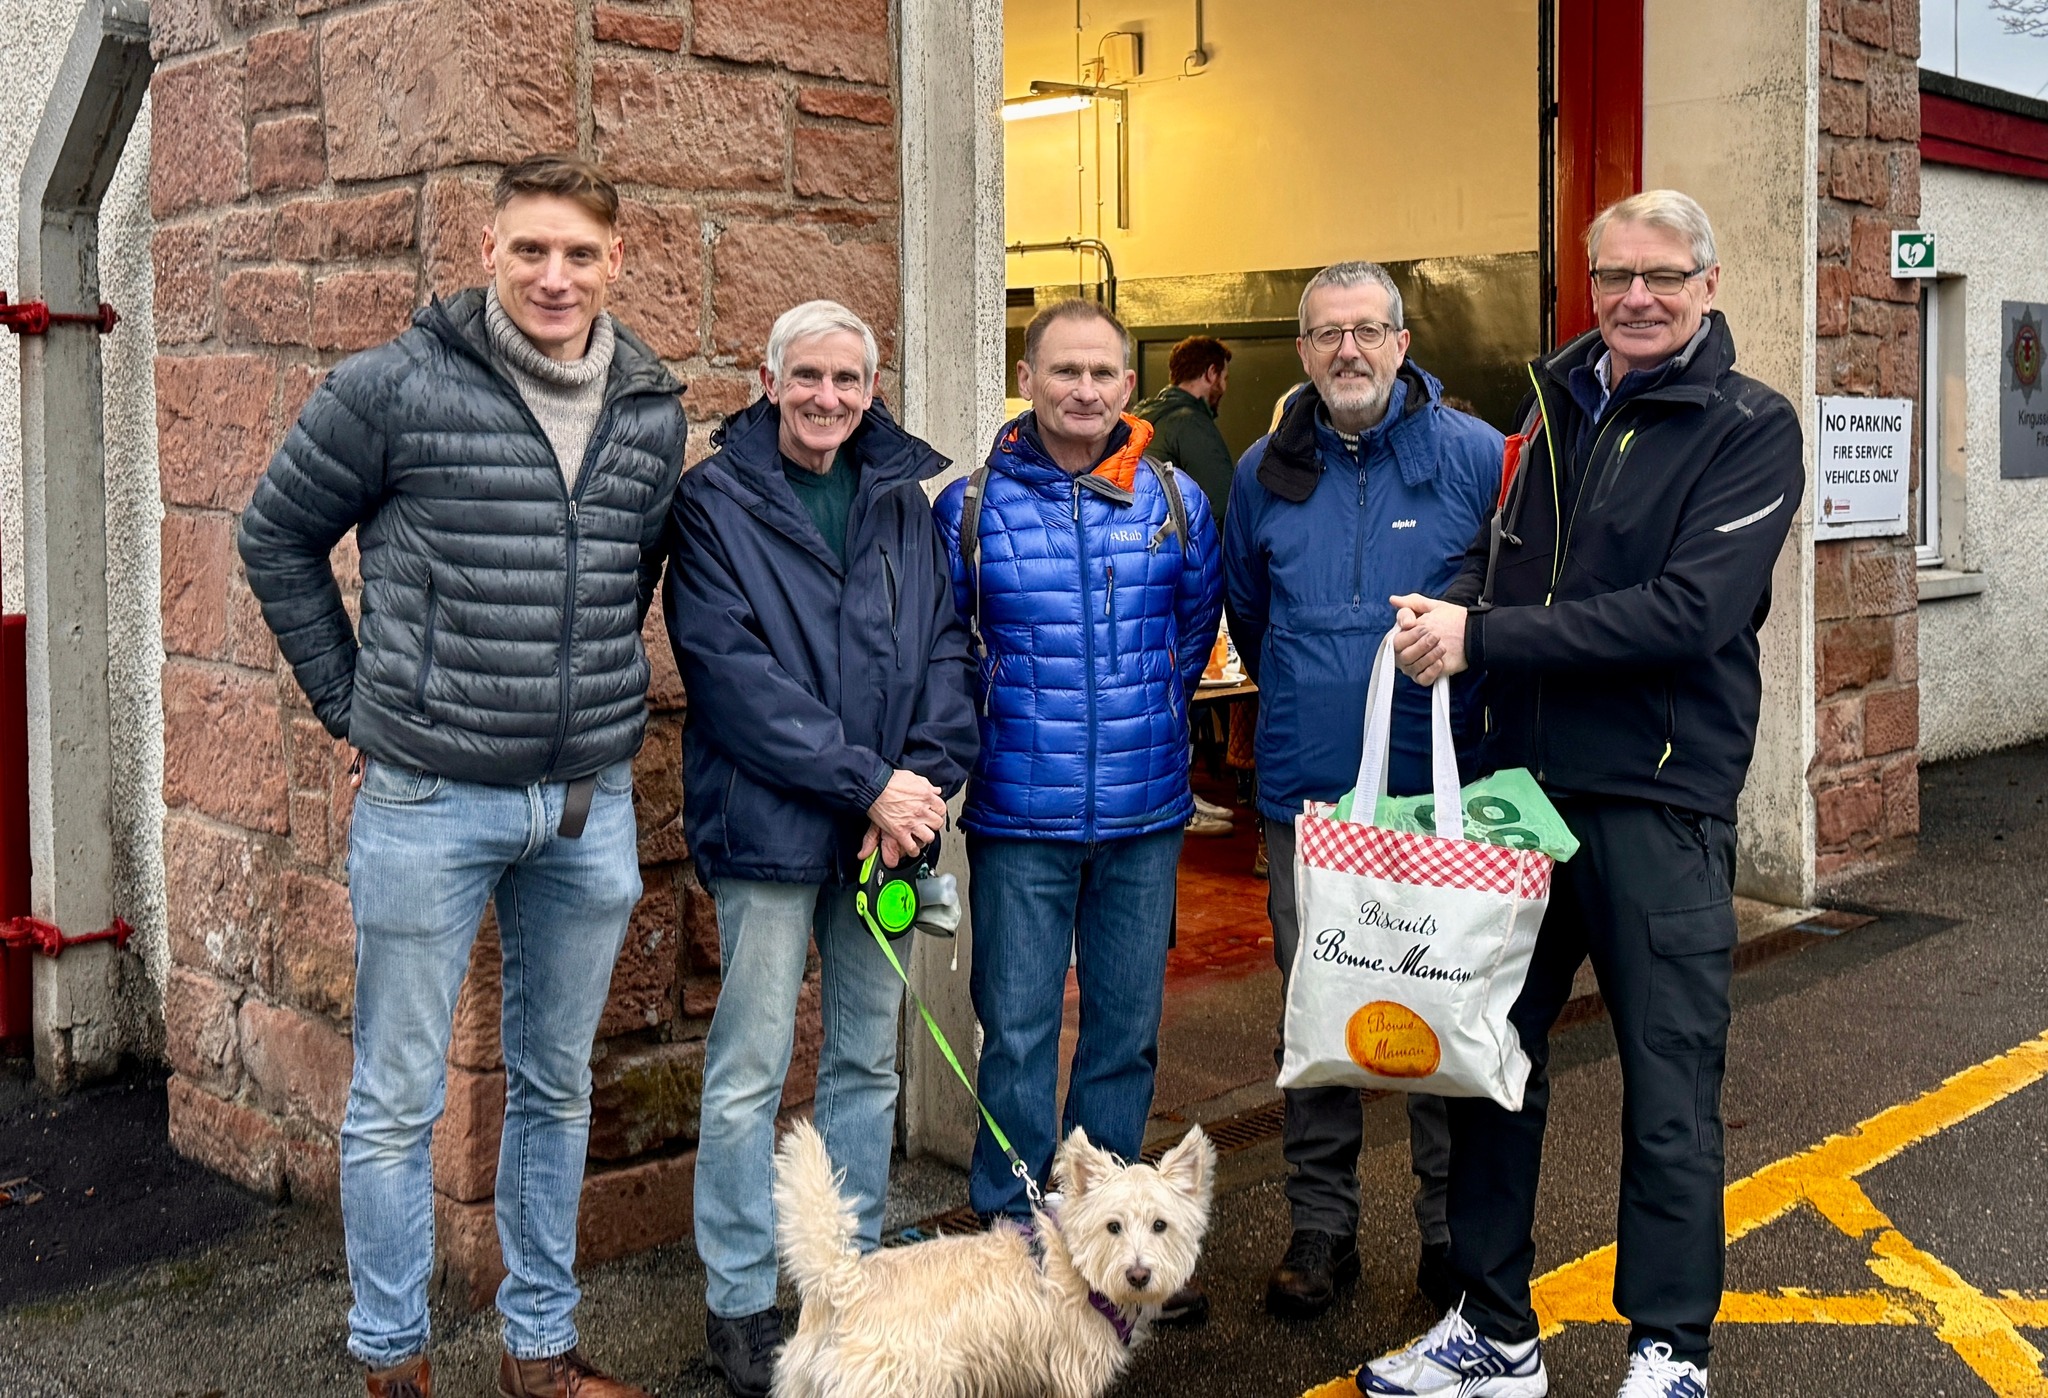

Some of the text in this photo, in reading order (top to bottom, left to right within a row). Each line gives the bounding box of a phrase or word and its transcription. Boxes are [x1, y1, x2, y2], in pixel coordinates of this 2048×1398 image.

[1825, 414, 1902, 432] NO PARKING
[1833, 445, 1893, 459] FIRE SERVICE
[1825, 469, 1899, 484] VEHICLES ONLY
[1391, 519, 1417, 530] alpkit
[1358, 900, 1439, 936] Biscuits
[1313, 928, 1385, 972] Bonne
[1368, 1011, 1416, 1033] Bonne
[1371, 1038, 1424, 1061] Maman
